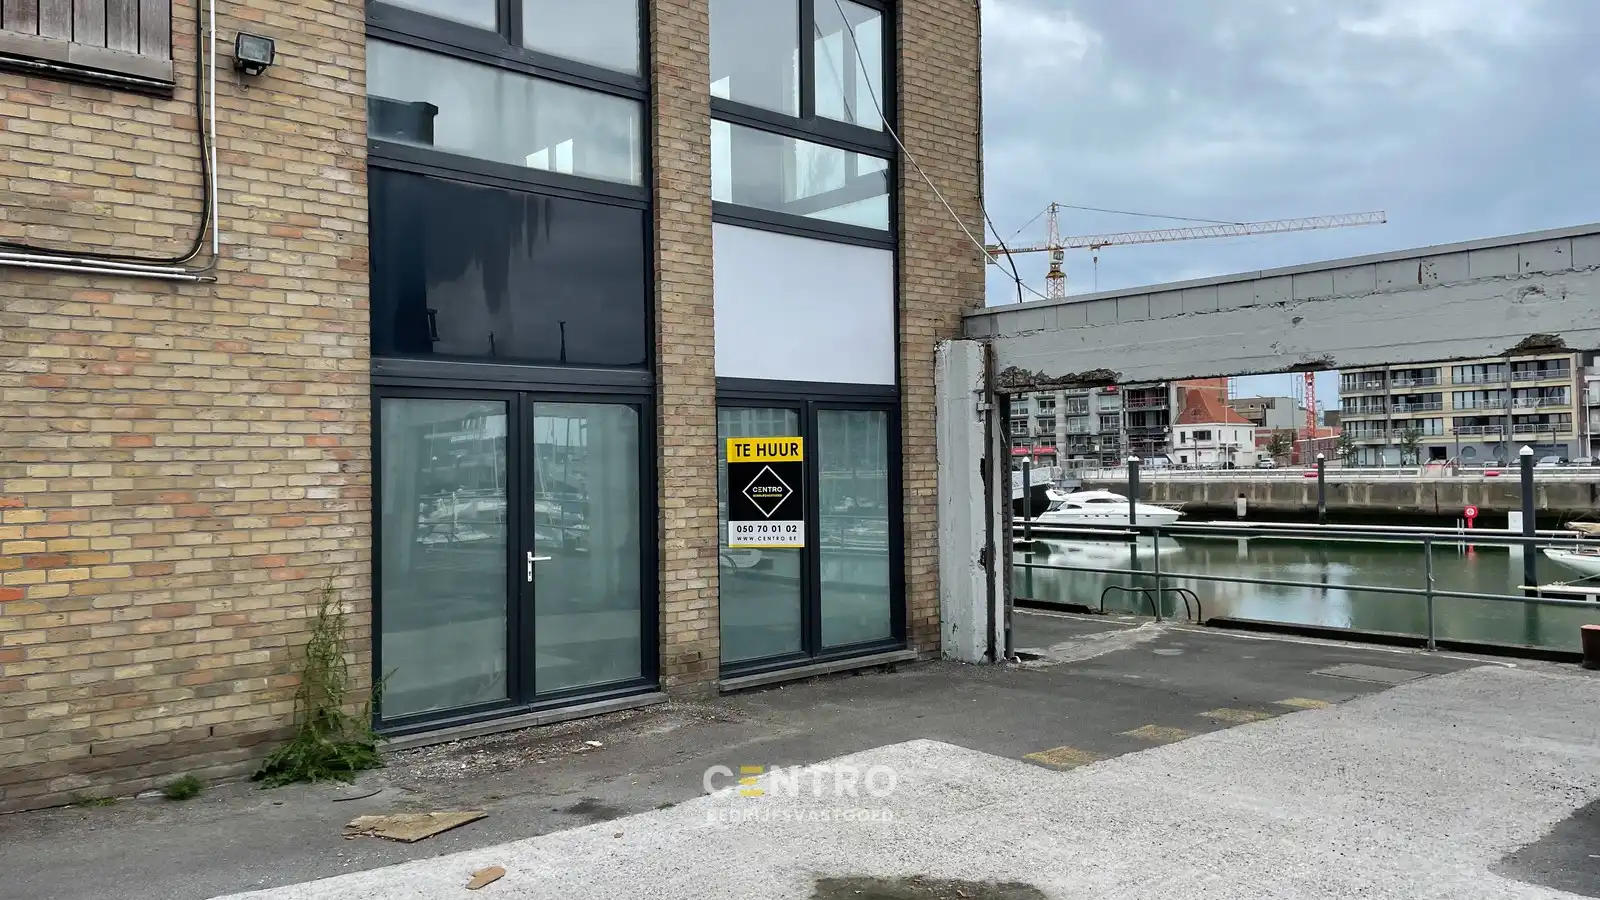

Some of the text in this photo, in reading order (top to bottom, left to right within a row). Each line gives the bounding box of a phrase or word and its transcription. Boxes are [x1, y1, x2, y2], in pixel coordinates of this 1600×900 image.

[735, 443, 799, 457] TE HUUR
[736, 525, 797, 533] 050 70 01 02
